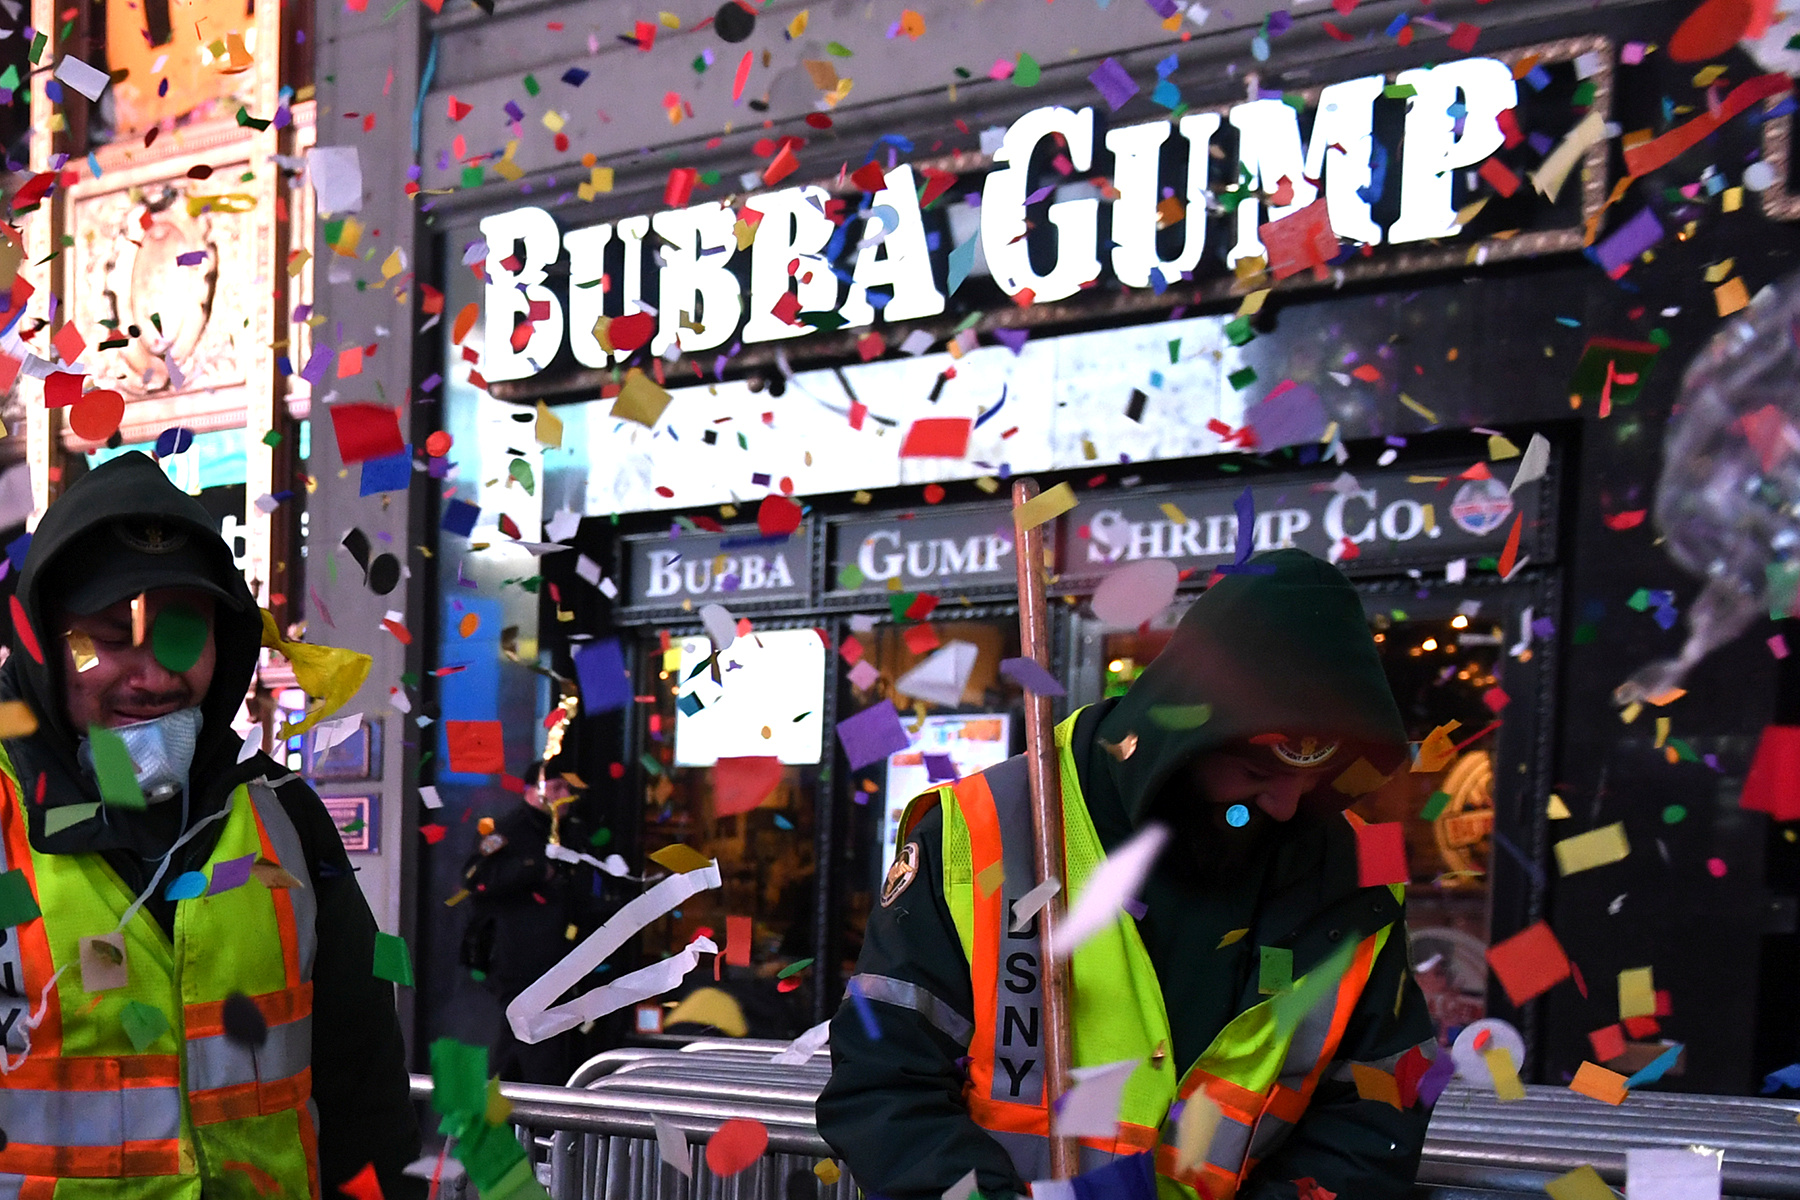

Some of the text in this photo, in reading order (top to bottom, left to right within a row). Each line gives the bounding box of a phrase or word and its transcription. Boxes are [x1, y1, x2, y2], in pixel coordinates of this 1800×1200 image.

[479, 57, 1519, 383] BUBBA GUMP
[646, 549, 794, 597] BUBBA
[857, 530, 1014, 581] GUMP
[1087, 507, 1311, 563] SHRIMP
